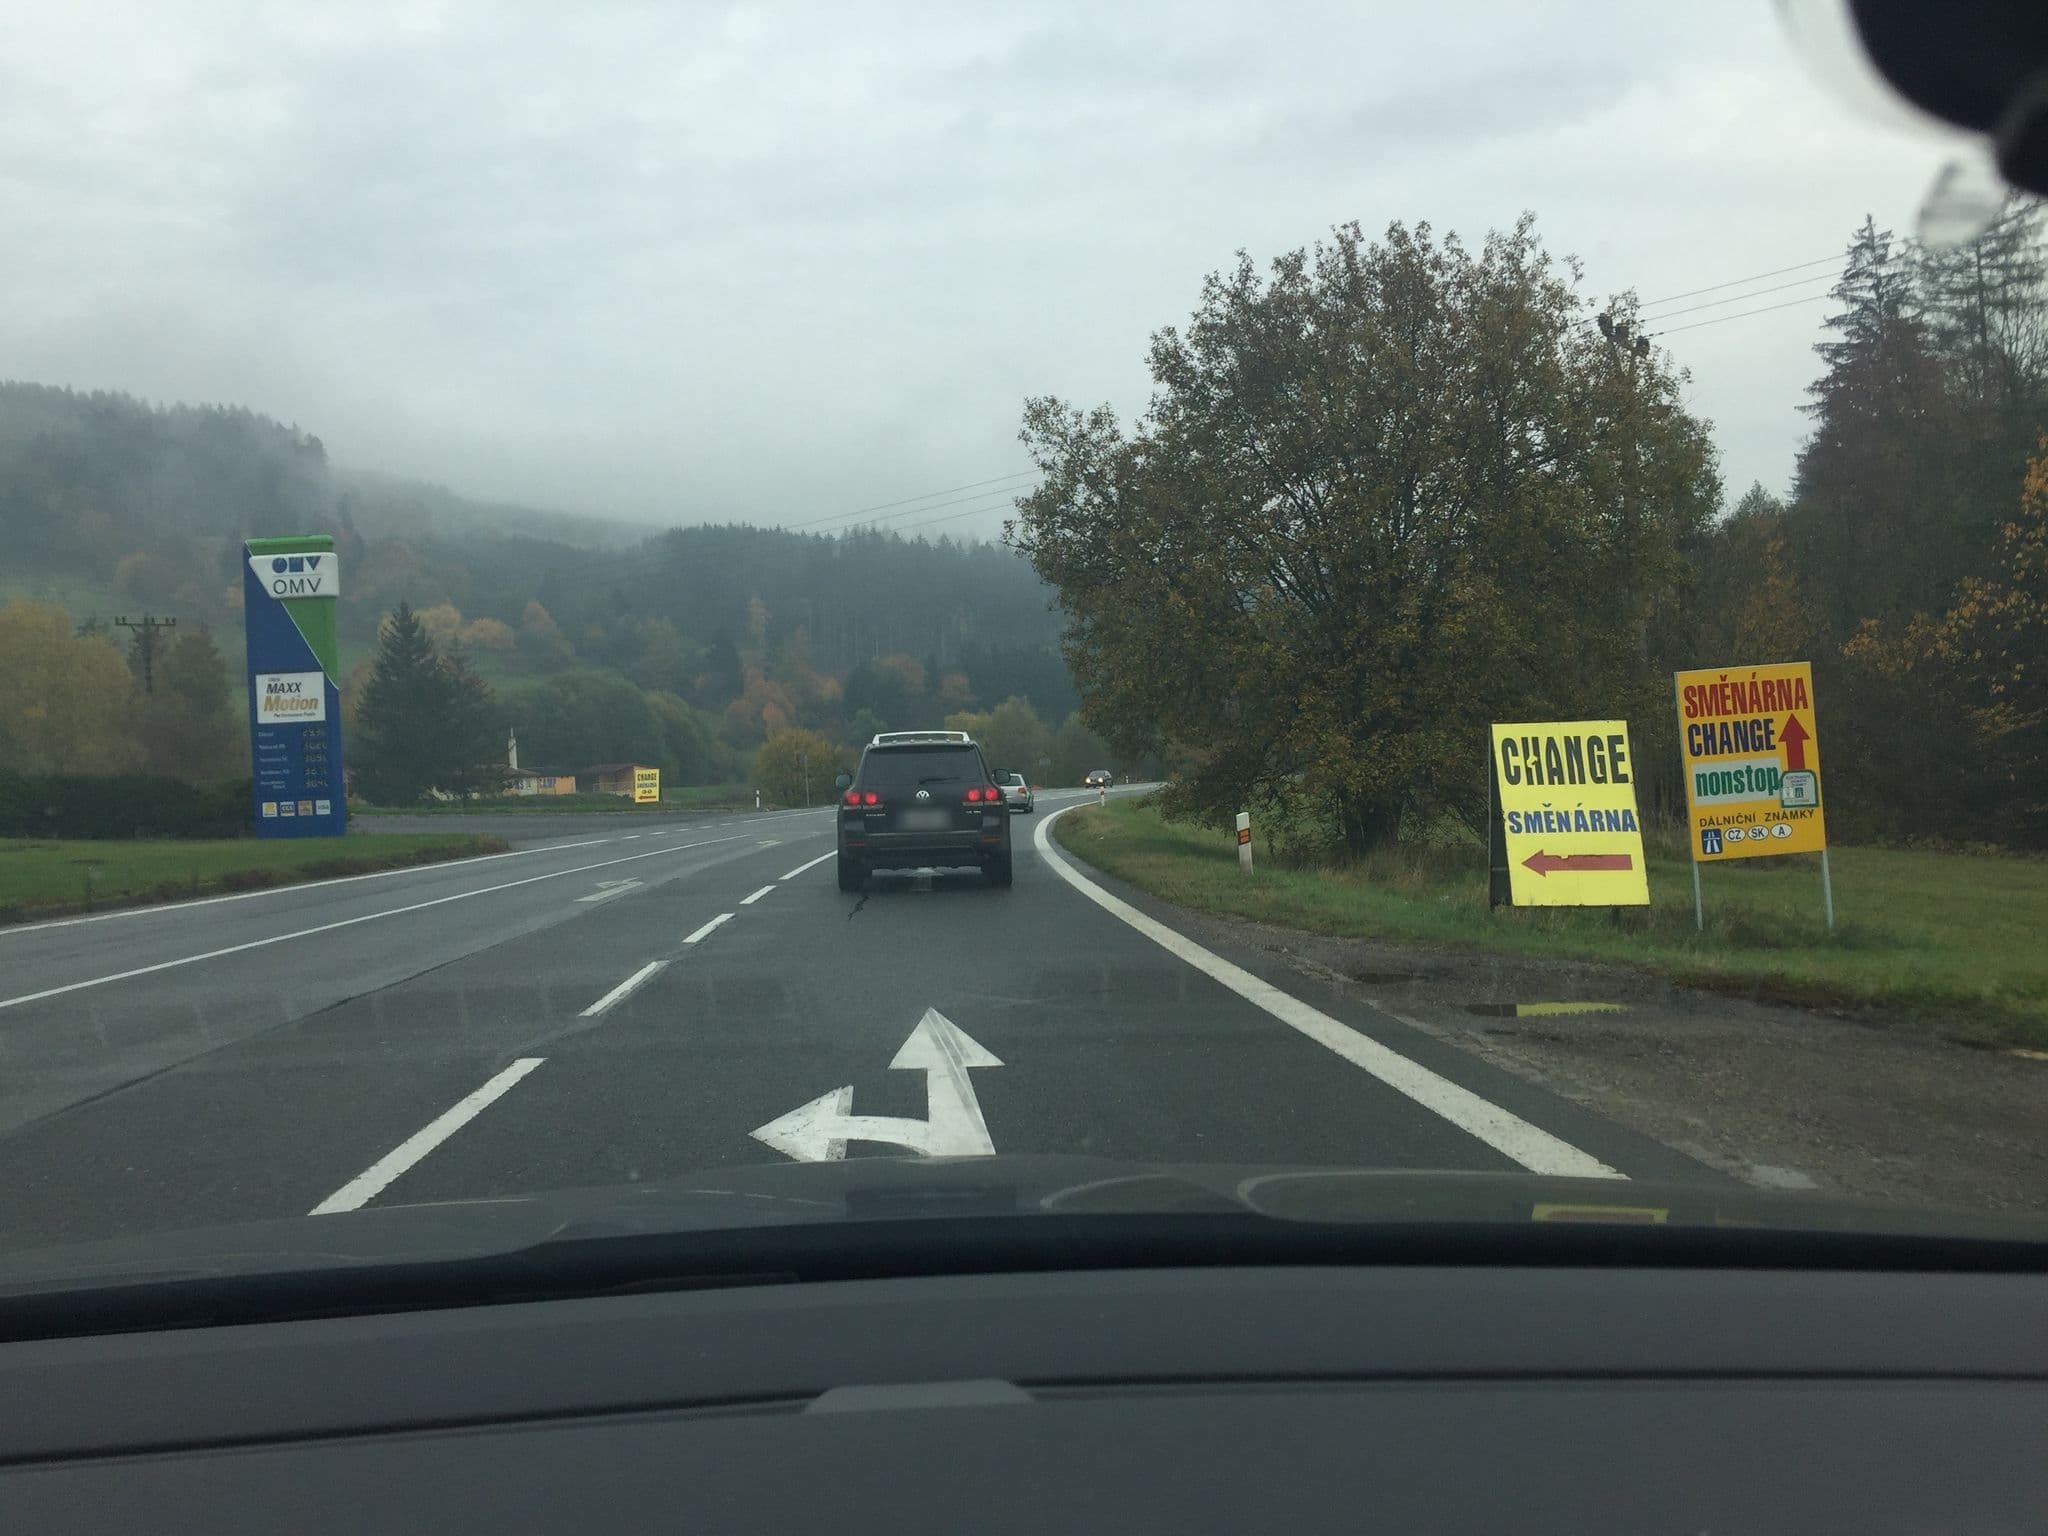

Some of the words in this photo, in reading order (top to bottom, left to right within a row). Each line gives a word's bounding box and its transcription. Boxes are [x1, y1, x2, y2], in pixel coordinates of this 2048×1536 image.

[273, 578, 322, 595] OMV
[264, 695, 319, 712] Motion
[266, 682, 302, 694] MAXX
[1683, 672, 1808, 718] SMĚNÁRNA
[1687, 718, 1776, 757] CHANGE
[1501, 734, 1629, 786] CHANGE
[1695, 765, 1782, 797] nonstop
[1507, 802, 1638, 833] SMĚNÁRNA
[1728, 829, 1742, 841] CZ
[1751, 827, 1765, 838] SK
[1778, 826, 1786, 836] A
